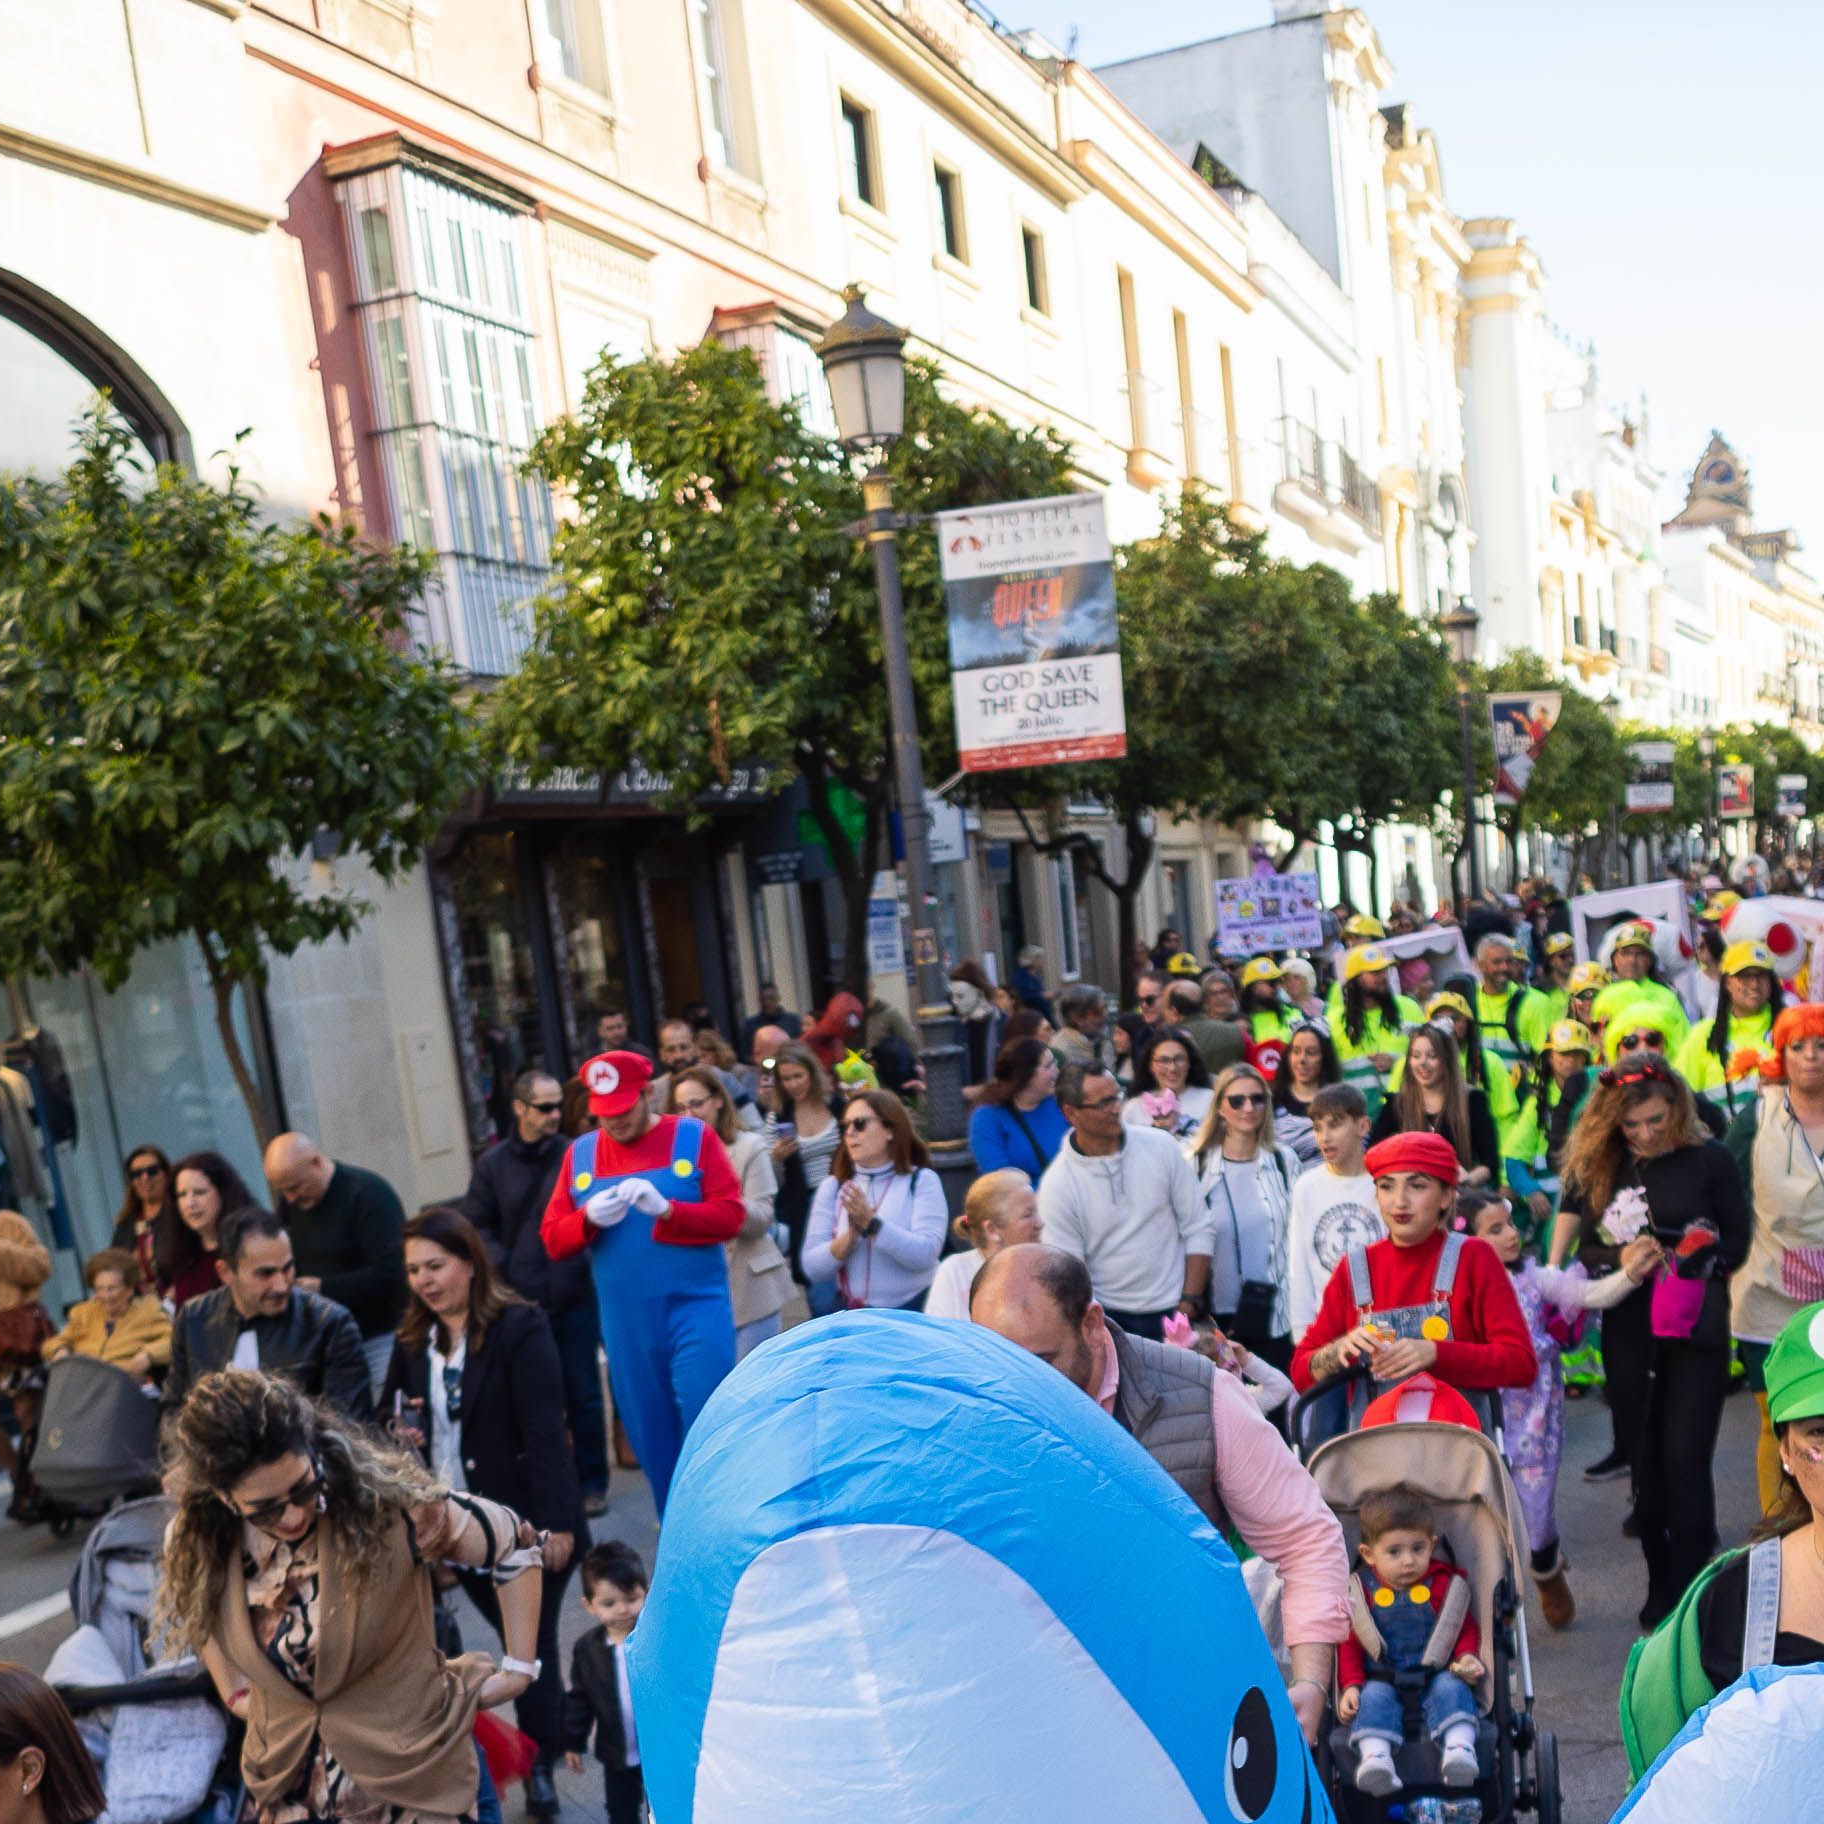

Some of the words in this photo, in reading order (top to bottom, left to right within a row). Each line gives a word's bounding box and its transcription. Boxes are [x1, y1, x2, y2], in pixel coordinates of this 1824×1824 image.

[981, 671, 1035, 694] GOD
[1041, 663, 1095, 687] SAVE
[979, 694, 1019, 717] THE
[1024, 686, 1100, 713] QUEEN
[595, 1068, 613, 1086] M
